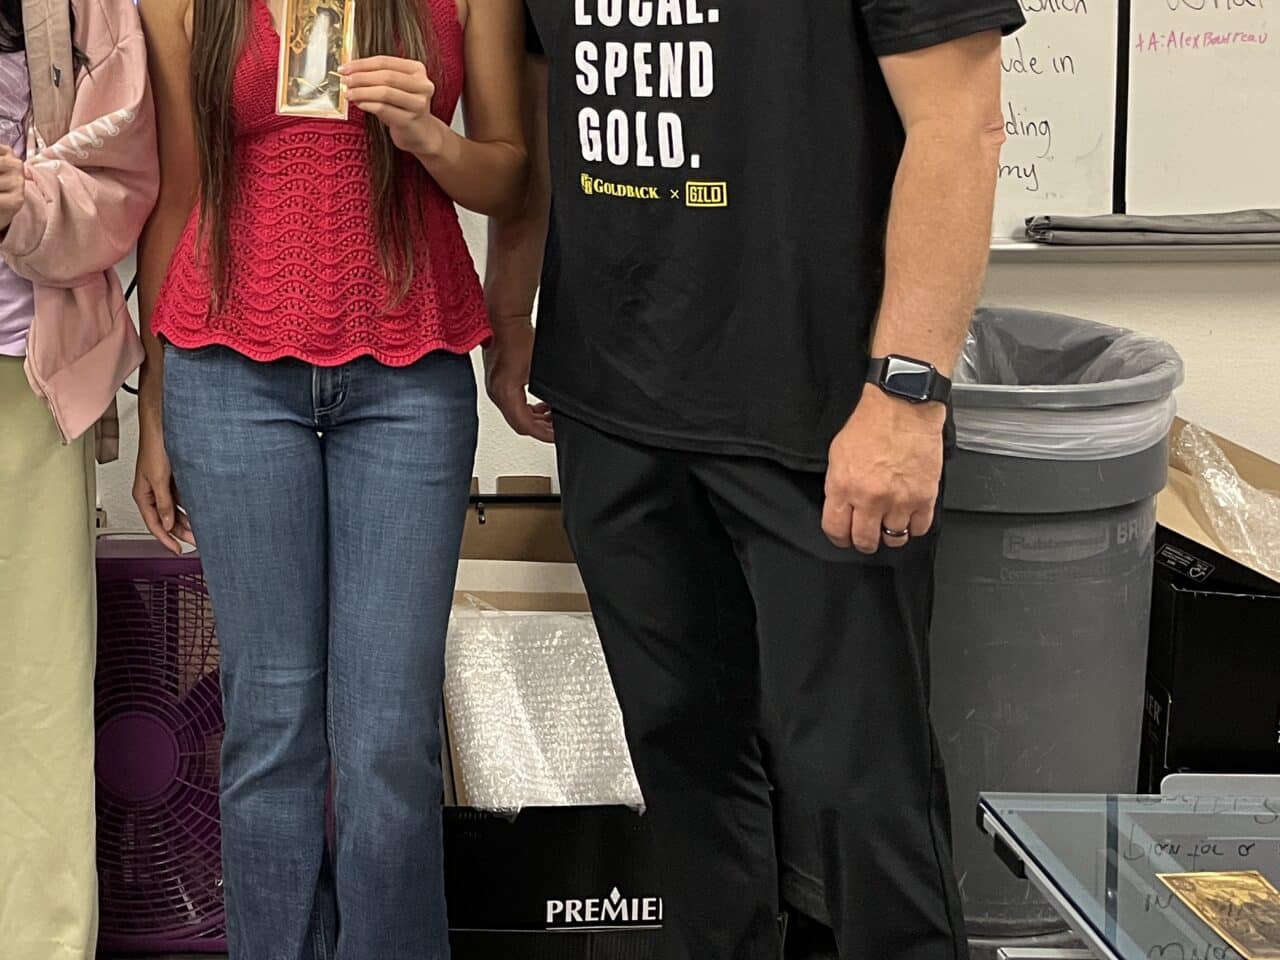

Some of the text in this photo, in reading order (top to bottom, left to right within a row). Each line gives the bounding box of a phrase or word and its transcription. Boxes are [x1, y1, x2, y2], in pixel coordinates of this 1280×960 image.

[574, 40, 715, 99] SPEND
[1052, 45, 1075, 75] in
[577, 106, 701, 169] GOLD.
[593, 177, 661, 200] GOLDBACK
[689, 184, 722, 204] GILD
[545, 896, 663, 923] PREMIE
